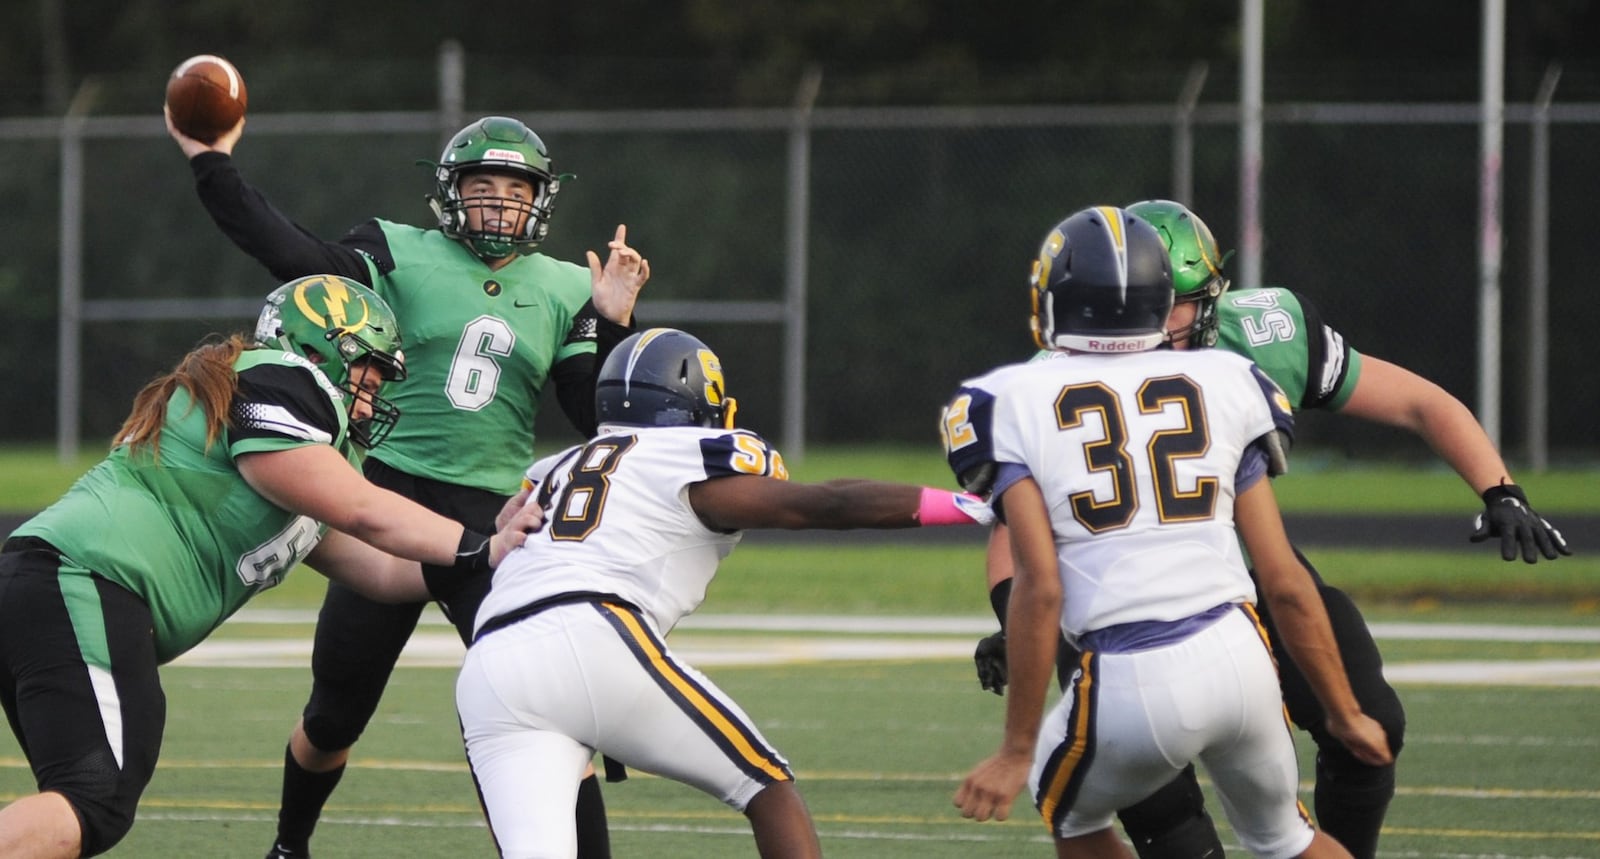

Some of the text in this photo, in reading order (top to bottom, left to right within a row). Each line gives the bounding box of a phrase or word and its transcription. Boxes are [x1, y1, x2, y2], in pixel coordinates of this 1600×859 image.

[1088, 340, 1146, 350] Riddell
[1232, 288, 1296, 347] 54
[444, 314, 516, 412] 6
[696, 348, 726, 406] S
[939, 394, 978, 453] 2
[1053, 373, 1220, 535] 32
[236, 514, 322, 588] 6
